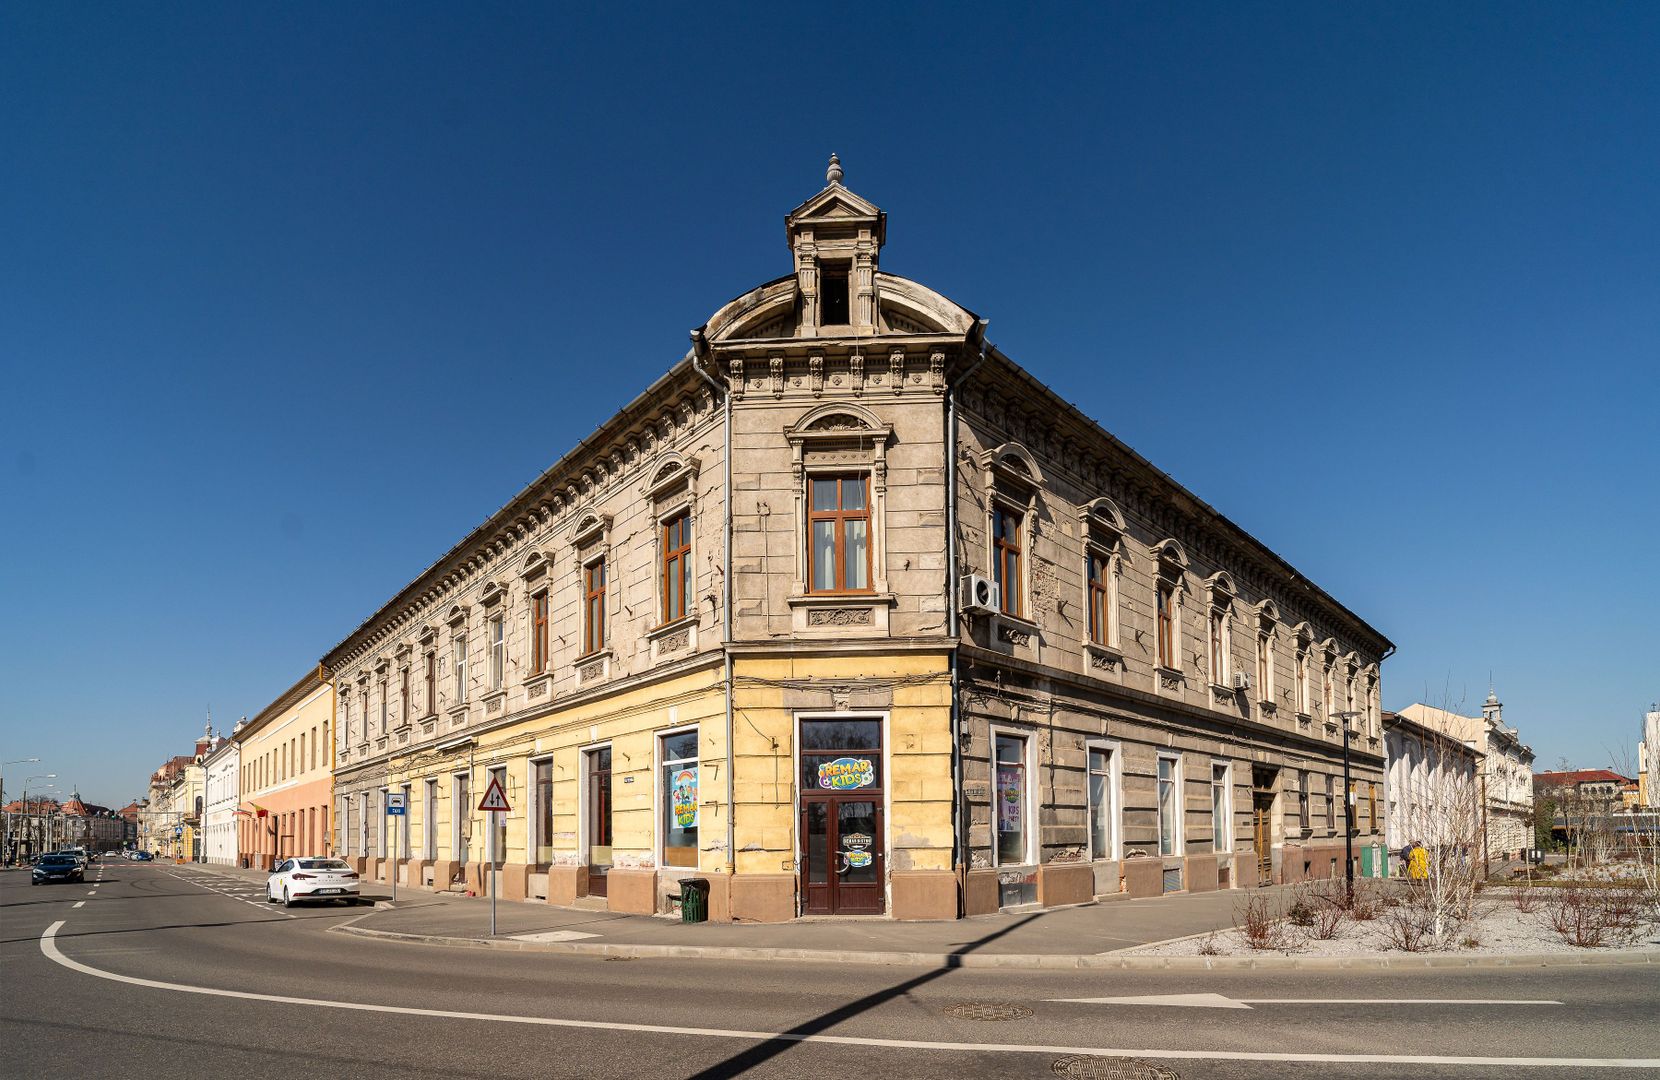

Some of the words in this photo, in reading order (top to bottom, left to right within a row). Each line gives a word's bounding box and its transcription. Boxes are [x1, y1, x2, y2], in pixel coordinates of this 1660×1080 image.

[825, 761, 869, 777] REMAR
[831, 773, 862, 787] KIDS
[675, 801, 697, 815] REMAR
[678, 813, 694, 825] KIDS
